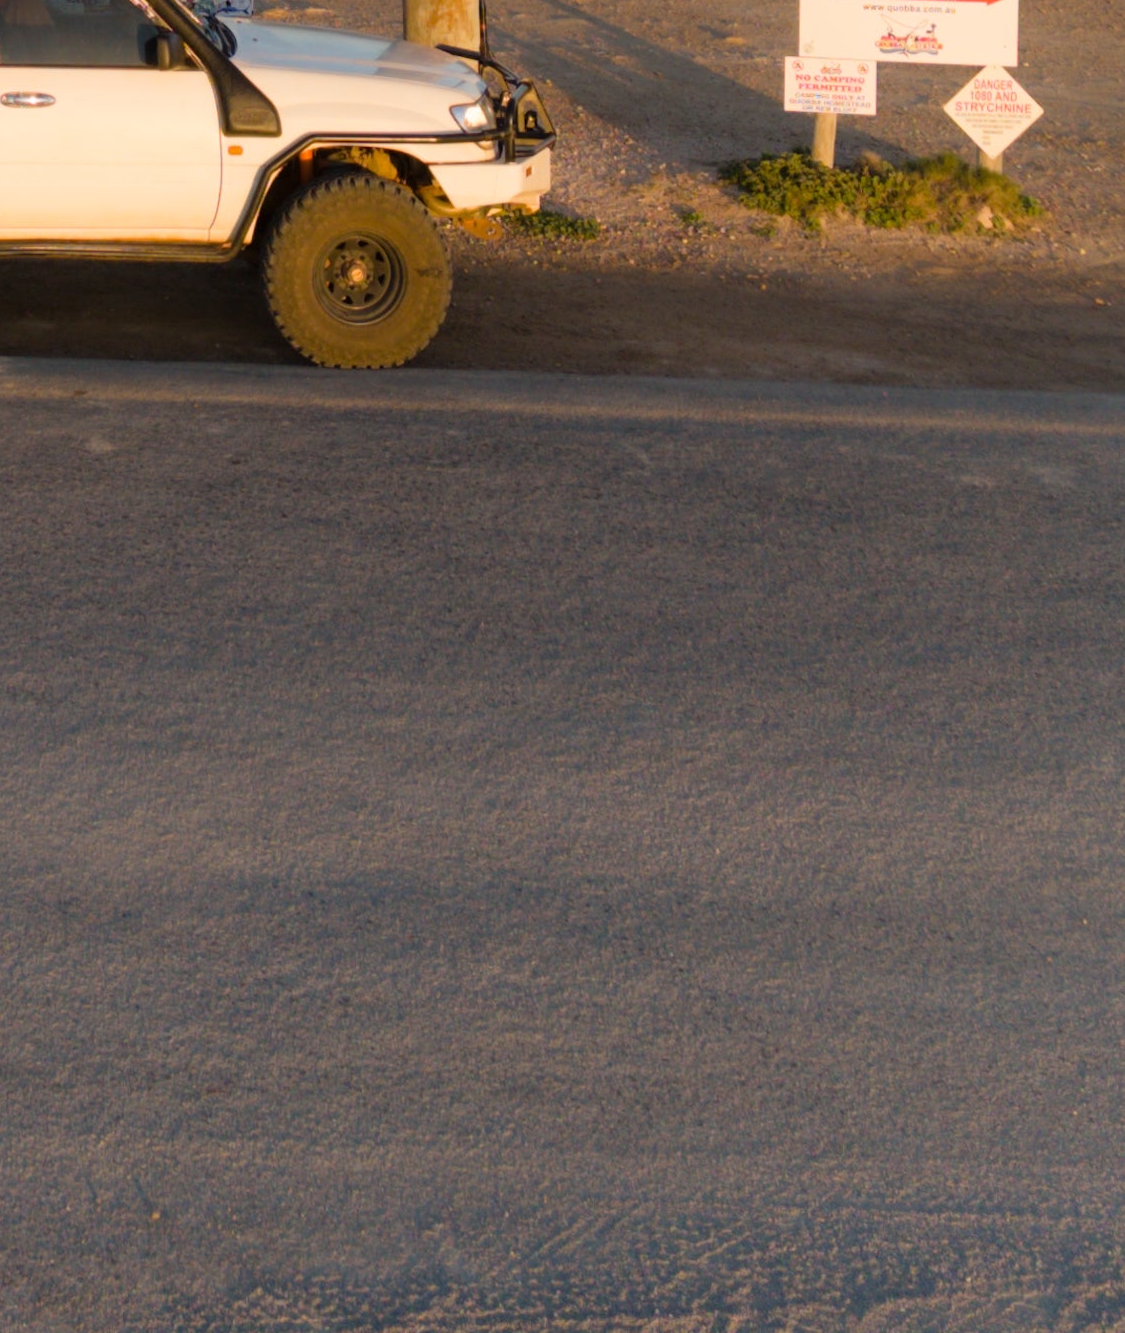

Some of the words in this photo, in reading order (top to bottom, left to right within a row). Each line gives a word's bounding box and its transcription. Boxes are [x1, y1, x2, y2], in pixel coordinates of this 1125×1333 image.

[795, 74, 812, 82] NO
[813, 75, 866, 84] CAMPING
[973, 78, 1013, 90] DANGER
[798, 83, 863, 93] PERMITTED
[995, 91, 1018, 102] AND
[954, 101, 1032, 114] STRYCHNINE
